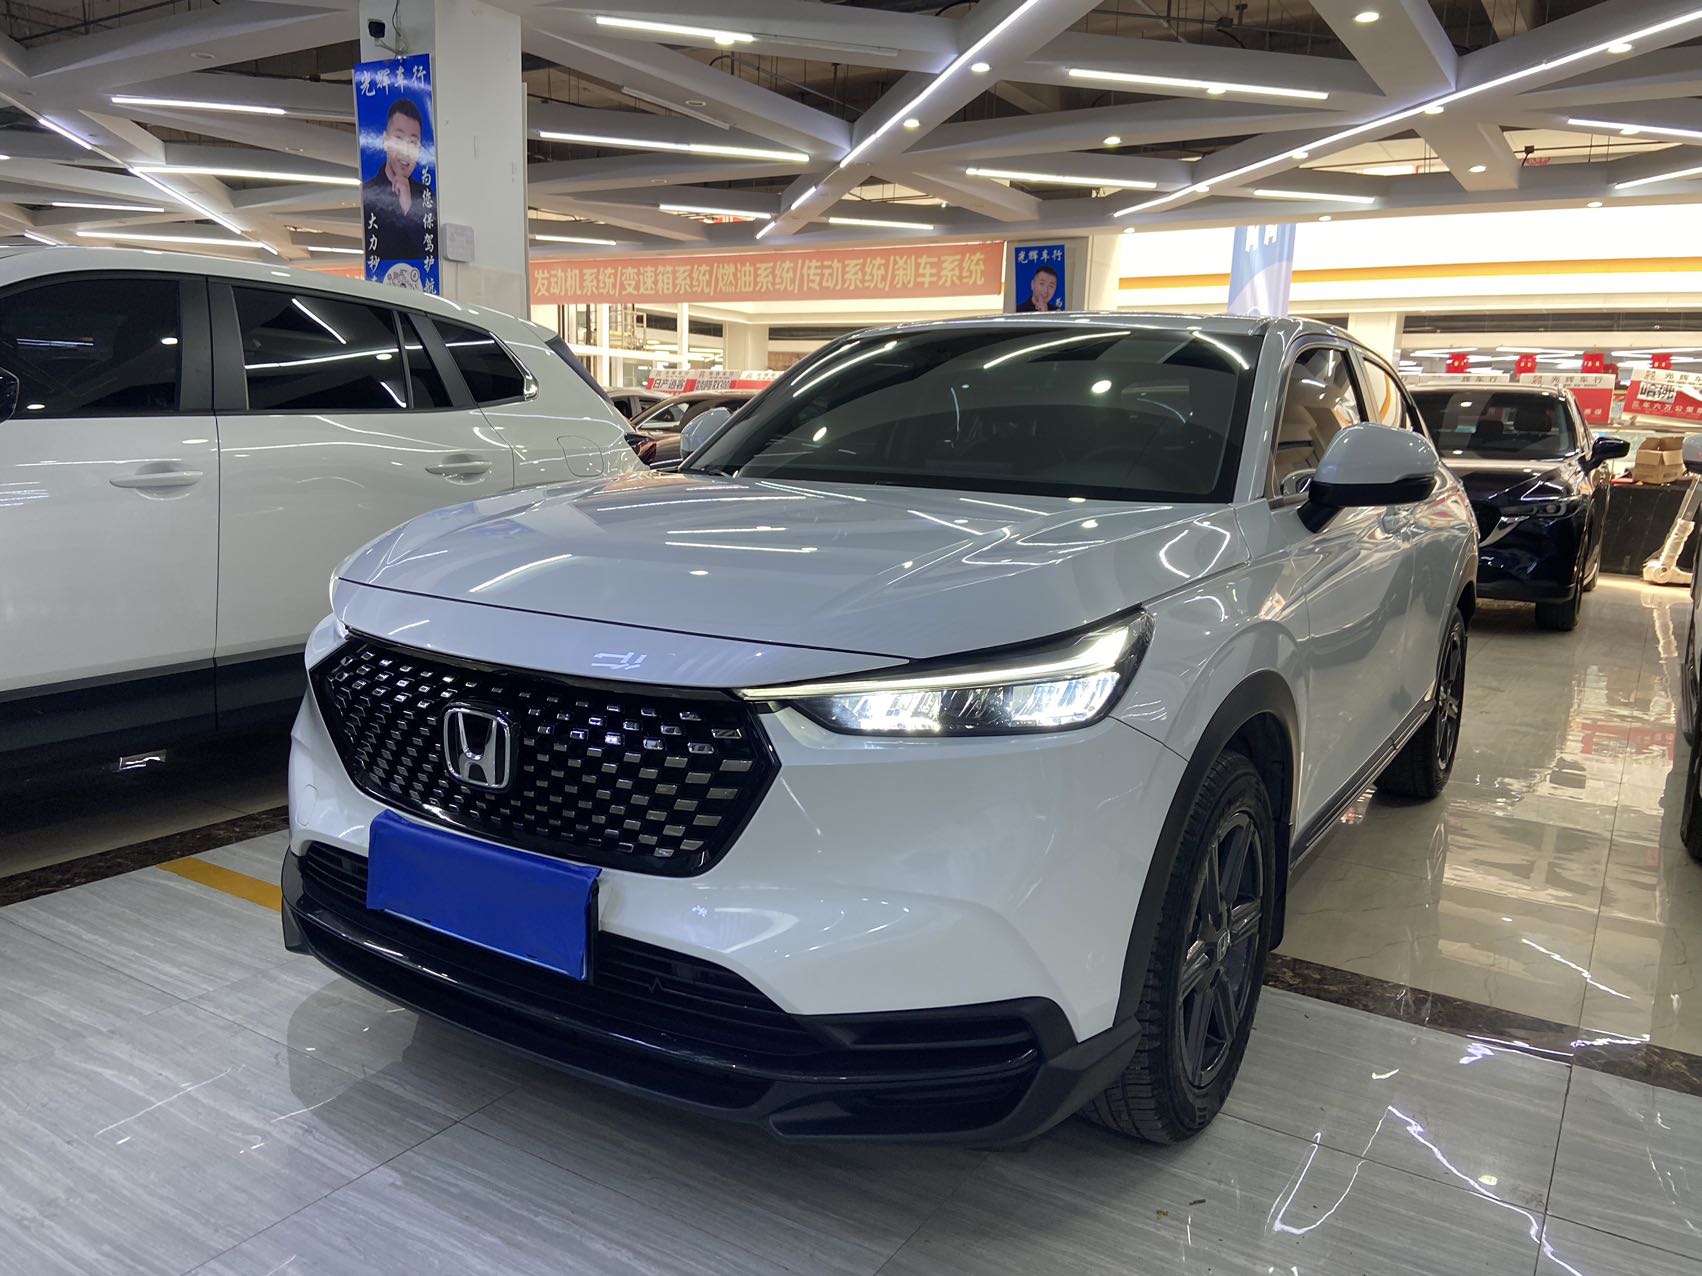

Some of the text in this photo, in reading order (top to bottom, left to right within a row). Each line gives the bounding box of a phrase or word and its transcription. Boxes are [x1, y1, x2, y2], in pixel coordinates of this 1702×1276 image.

[360, 65, 427, 97] 光辉车行
[421, 166, 437, 294] 为您保驾护航
[534, 251, 985, 297] 发动机系统/变速箱系统/燃油系统/传动系统/刹车系统
[1018, 249, 1062, 264] 光辉车行
